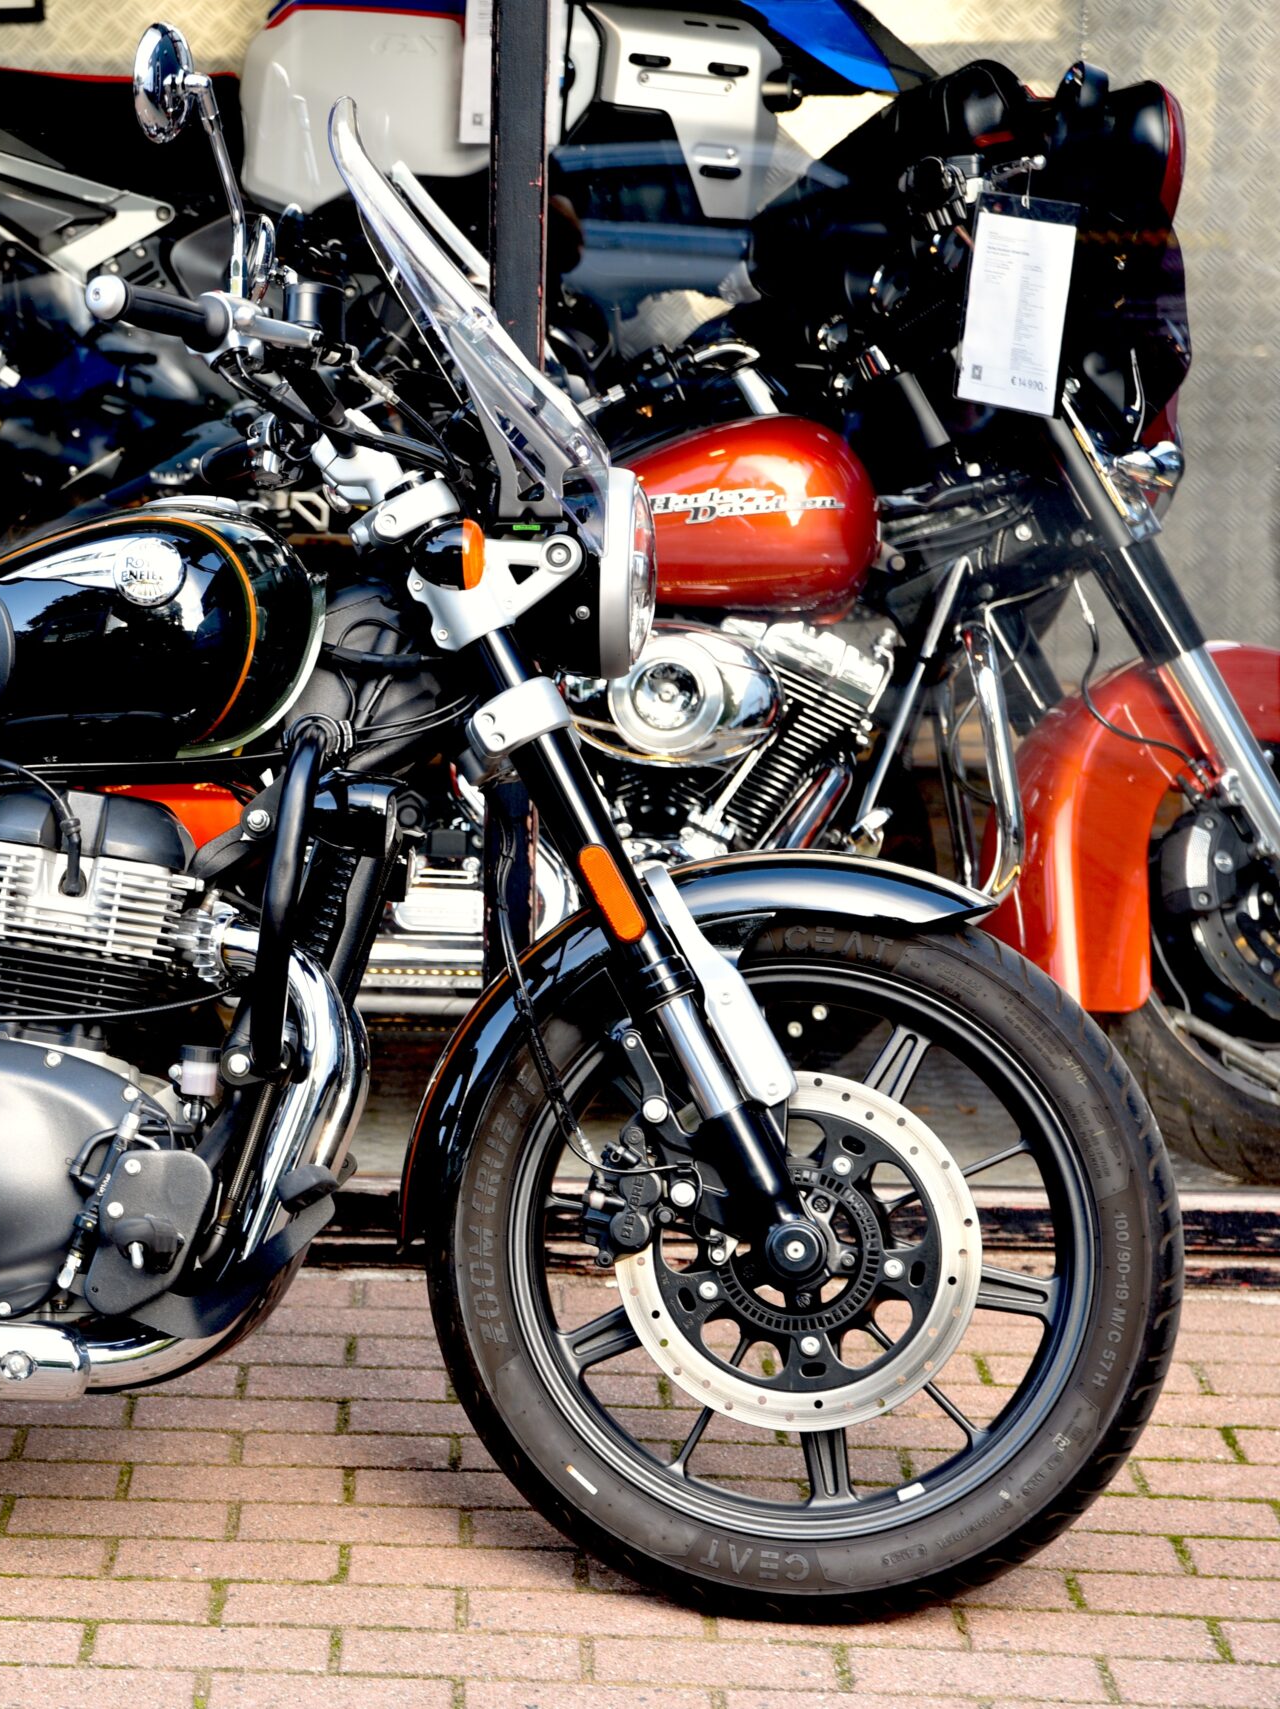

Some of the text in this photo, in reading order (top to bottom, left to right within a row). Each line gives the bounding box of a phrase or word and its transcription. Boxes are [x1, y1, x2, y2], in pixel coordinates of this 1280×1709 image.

[686, 495, 846, 524] Davidon
[121, 570, 163, 582] ENFIE
[784, 926, 894, 962] CEAT
[1114, 1211, 1132, 1300] 100/90-19
[468, 1223, 509, 1344] ZOOM
[1107, 1307, 1127, 1344] M/C
[699, 1538, 810, 1582] CEAT
